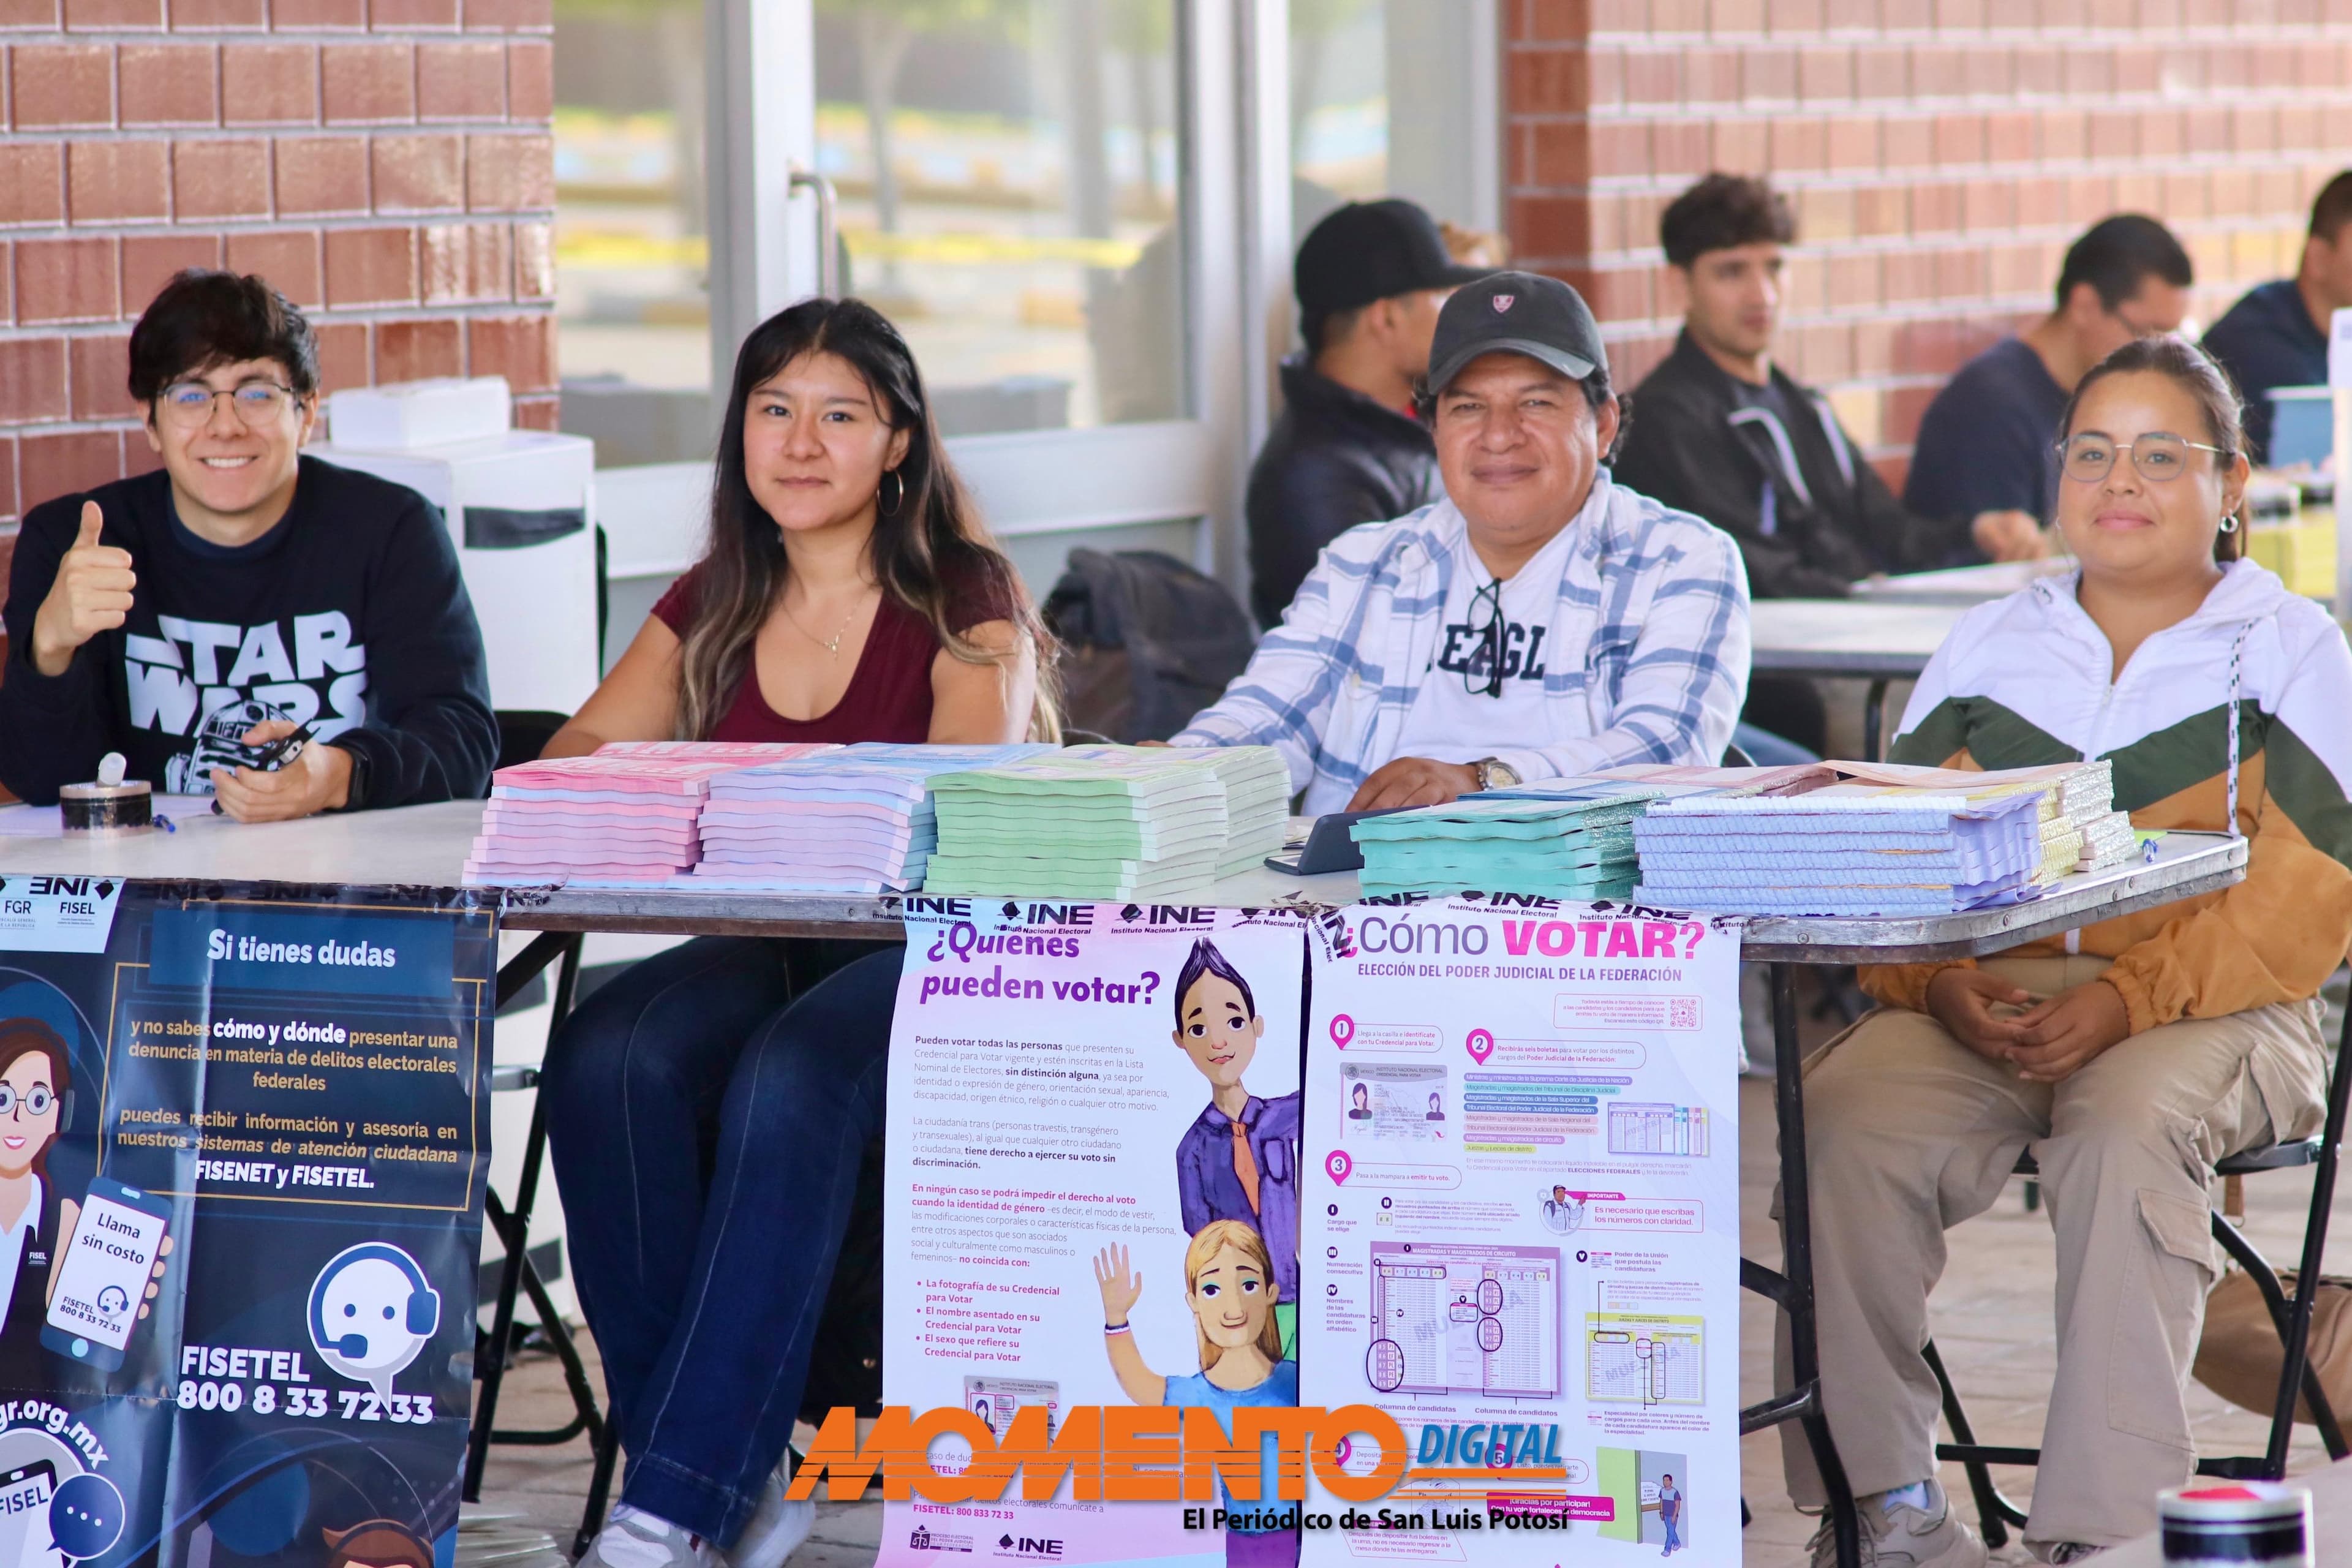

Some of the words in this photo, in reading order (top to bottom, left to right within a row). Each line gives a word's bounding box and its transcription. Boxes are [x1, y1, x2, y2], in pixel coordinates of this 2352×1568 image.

[125, 610, 366, 686] STAR
[5, 900, 32, 914] FGR
[59, 902, 96, 914] FISEL
[907, 898, 972, 918] INE
[1447, 903, 1482, 913] Instituto
[1520, 910, 1557, 918] Electoral
[1490, 892, 1562, 910] INE
[1027, 903, 1095, 925] INE
[1149, 905, 1216, 925] INE
[207, 929, 233, 960] Si
[239, 935, 312, 965] tienes
[318, 939, 396, 968] dudas
[1502, 920, 1705, 960] VOTAR?
[1358, 961, 1415, 976] ELECCIÓN
[1419, 964, 1441, 977] DEL
[1446, 965, 1490, 978] PODER
[1494, 966, 1555, 979] JUDICIAL
[1559, 968, 1575, 980] DE
[1580, 968, 1594, 981] LA
[1600, 966, 1681, 981] FEDERACIÓN
[920, 965, 1044, 1005] pueden
[1052, 971, 1160, 1005] votar?
[130, 1021, 140, 1036] y
[143, 1022, 163, 1034] no
[167, 1020, 211, 1036] sabes
[213, 1018, 265, 1039] cómo
[268, 1024, 280, 1046] y
[283, 1021, 346, 1043] dónde
[349, 1031, 425, 1047] presentar
[428, 1035, 458, 1049] una
[1476, 1037, 1483, 1050] 2
[915, 1036, 949, 1045] Pueden
[978, 1039, 1004, 1048] todas
[1006, 1039, 1019, 1048] las
[1020, 1041, 1063, 1050] personas
[1065, 1044, 1080, 1053] que
[1083, 1045, 1123, 1054] presenten
[129, 1041, 201, 1060] denuncia
[205, 1049, 222, 1061] en
[225, 1048, 284, 1065] materia
[287, 1049, 307, 1065] de
[311, 1050, 364, 1068] delitos
[368, 1054, 457, 1073] electorales
[253, 1071, 326, 1091] federales
[119, 1108, 181, 1125] puedes
[190, 1111, 238, 1128] recibir
[246, 1112, 338, 1133] información
[345, 1121, 355, 1138] y
[363, 1121, 429, 1138] asesoría
[437, 1127, 457, 1139] en
[118, 1131, 187, 1148] nuestros
[195, 1134, 264, 1153] sistemas
[271, 1138, 292, 1154] de
[298, 1140, 368, 1158] atención
[374, 1144, 458, 1163] ciudadana
[194, 1159, 276, 1183] FISENET
[276, 1167, 290, 1189] y
[292, 1164, 375, 1188] FISETEL.
[1335, 1158, 1343, 1172] 3
[912, 1183, 924, 1193] En
[926, 1184, 957, 1196] ningún
[993, 1189, 1019, 1199] podrá
[1022, 1189, 1056, 1201] impedir
[1058, 1192, 1066, 1200] el
[1068, 1193, 1104, 1202] derecho
[1106, 1195, 1114, 1204] al
[1116, 1196, 1136, 1205] voto
[97, 1213, 141, 1239] Llama
[1608, 1215, 1643, 1224] números
[29, 1251, 47, 1261] FISEL
[81, 1234, 103, 1250] sin
[106, 1243, 145, 1264] costo
[926, 1279, 937, 1287] La
[939, 1280, 984, 1292] fotografía
[986, 1283, 997, 1291] de
[1012, 1284, 1060, 1295] Credencial
[62, 1296, 94, 1314] FISETEL
[925, 1294, 946, 1303] para
[948, 1294, 973, 1303] Votar
[60, 1305, 77, 1316] 800
[78, 1311, 84, 1319] 8
[86, 1314, 97, 1324] 33
[99, 1319, 109, 1329] 72
[110, 1323, 122, 1333] 33
[181, 1345, 310, 1383] FISETEL
[176, 1380, 243, 1412] 800
[252, 1384, 276, 1415] 8
[284, 1387, 328, 1418] 33
[337, 1390, 382, 1422] 72
[390, 1393, 434, 1425] 33
[913, 1504, 955, 1516] FISETEL:
[956, 1506, 972, 1517] 800
[973, 1508, 989, 1518] 833
[991, 1509, 1001, 1518] 72
[1003, 1510, 1014, 1520] 33
[1019, 1537, 1063, 1555] INE
